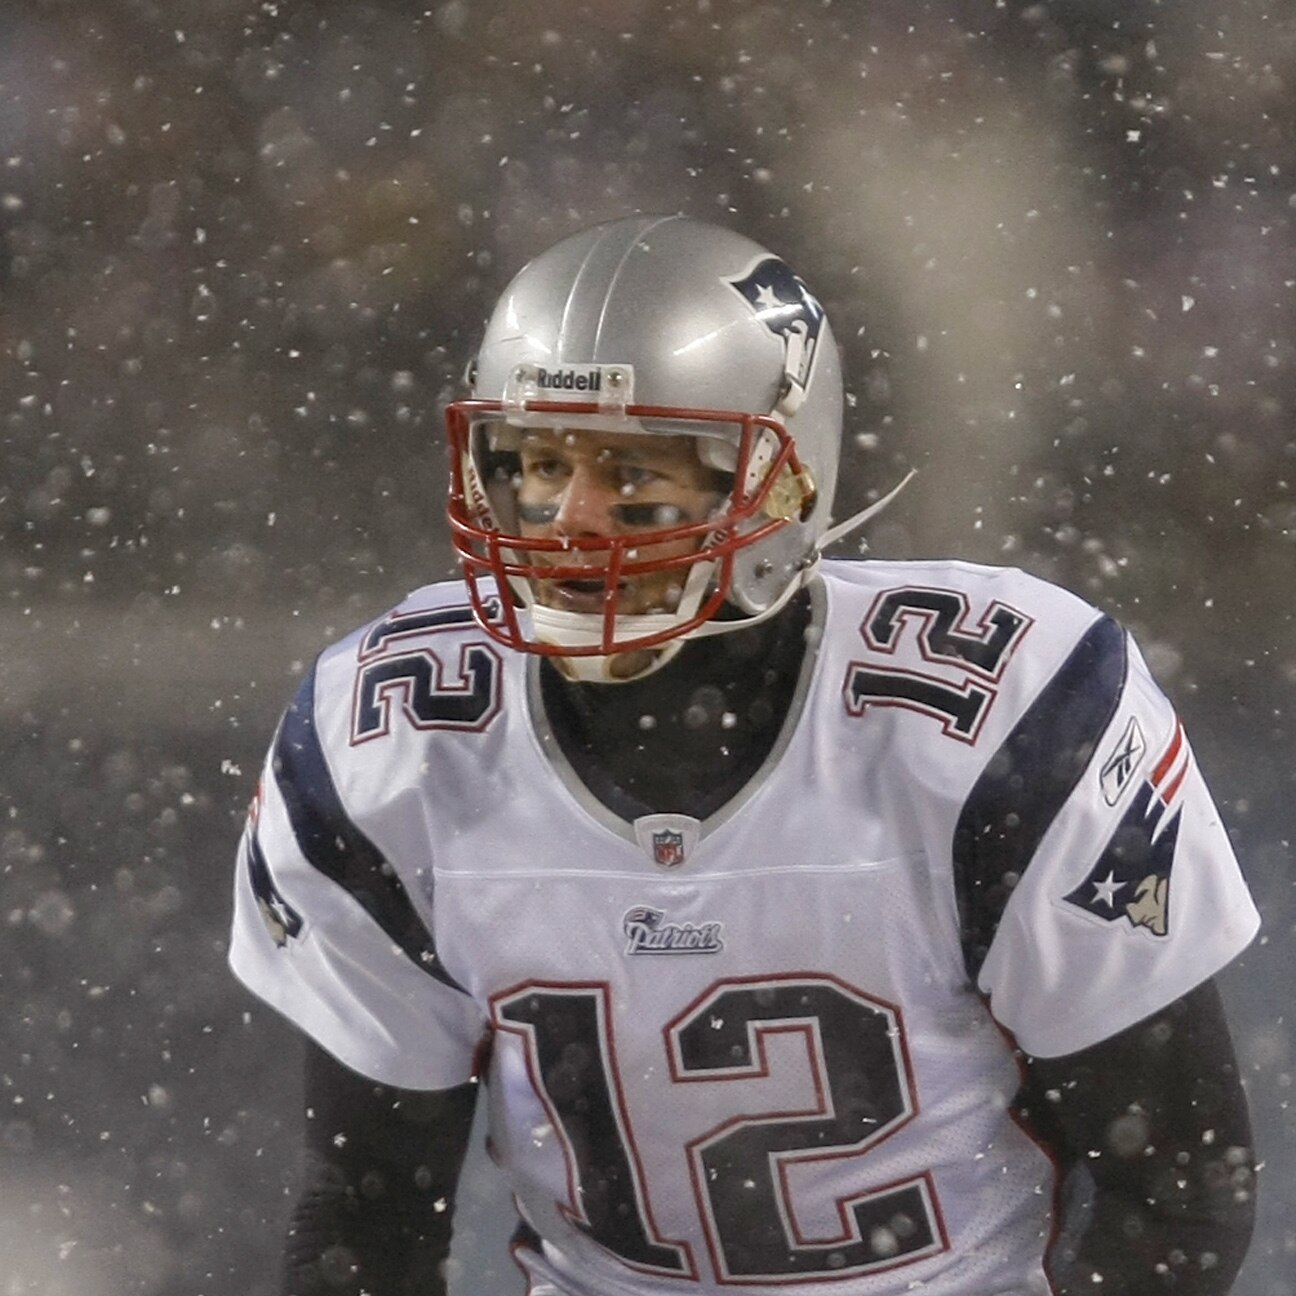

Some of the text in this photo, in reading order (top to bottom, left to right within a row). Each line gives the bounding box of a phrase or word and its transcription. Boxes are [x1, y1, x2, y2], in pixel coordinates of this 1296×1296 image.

[536, 366, 602, 391] Riddell
[349, 594, 504, 747] 12
[842, 584, 1036, 747] 12
[488, 971, 952, 1286] 12
